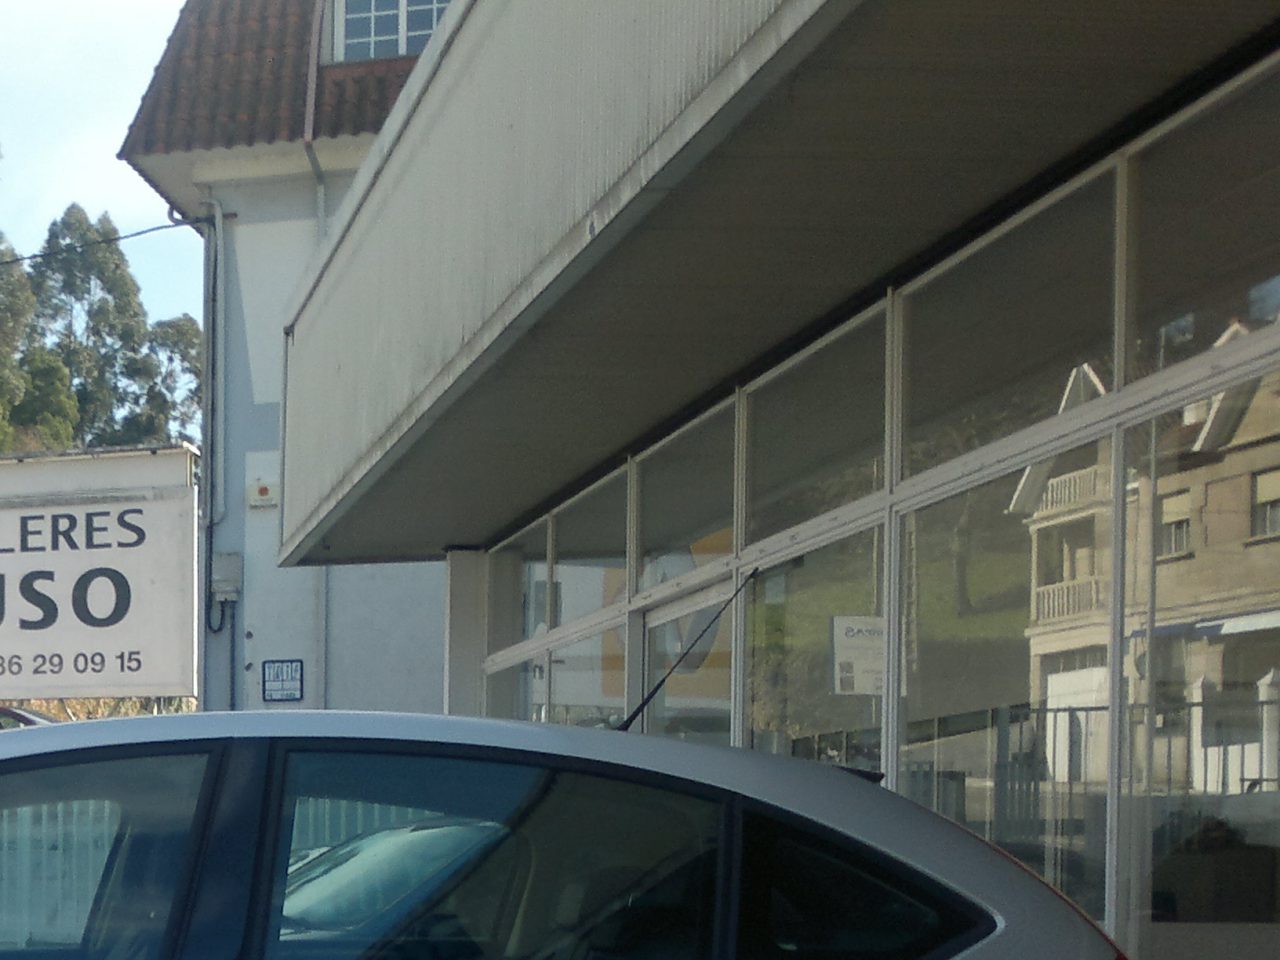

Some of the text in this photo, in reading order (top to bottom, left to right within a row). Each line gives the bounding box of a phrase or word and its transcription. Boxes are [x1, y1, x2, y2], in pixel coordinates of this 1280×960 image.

[32, 653, 64, 675] 29
[73, 652, 106, 674] 09
[115, 651, 142, 673] 15
